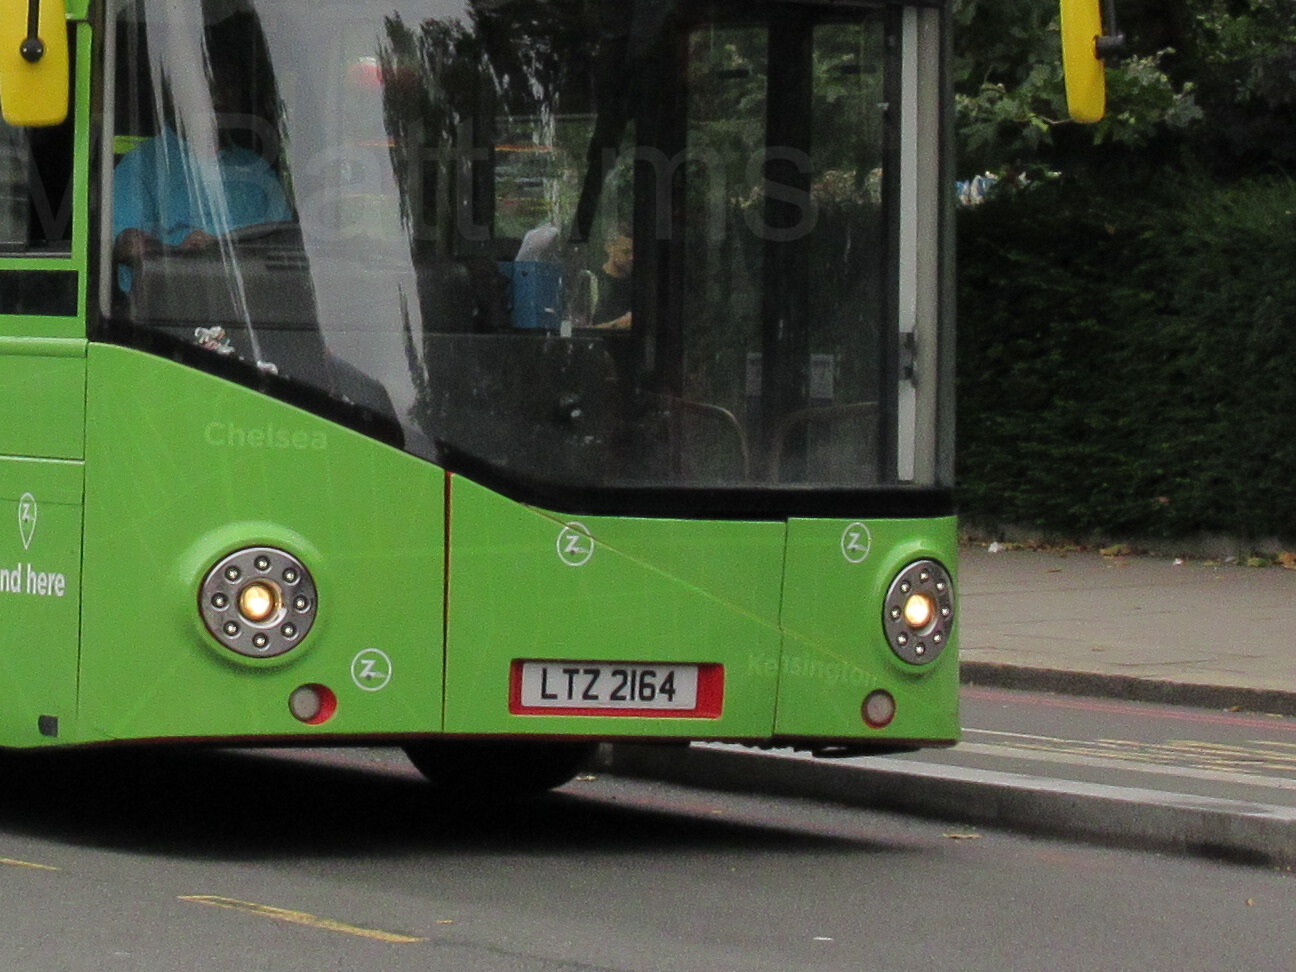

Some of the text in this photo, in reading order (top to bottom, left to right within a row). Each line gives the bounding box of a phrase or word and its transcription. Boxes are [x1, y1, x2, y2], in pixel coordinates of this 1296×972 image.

[204, 420, 328, 450] Chelsea
[25, 564, 65, 598] here
[541, 668, 676, 703] LTZ 2164
